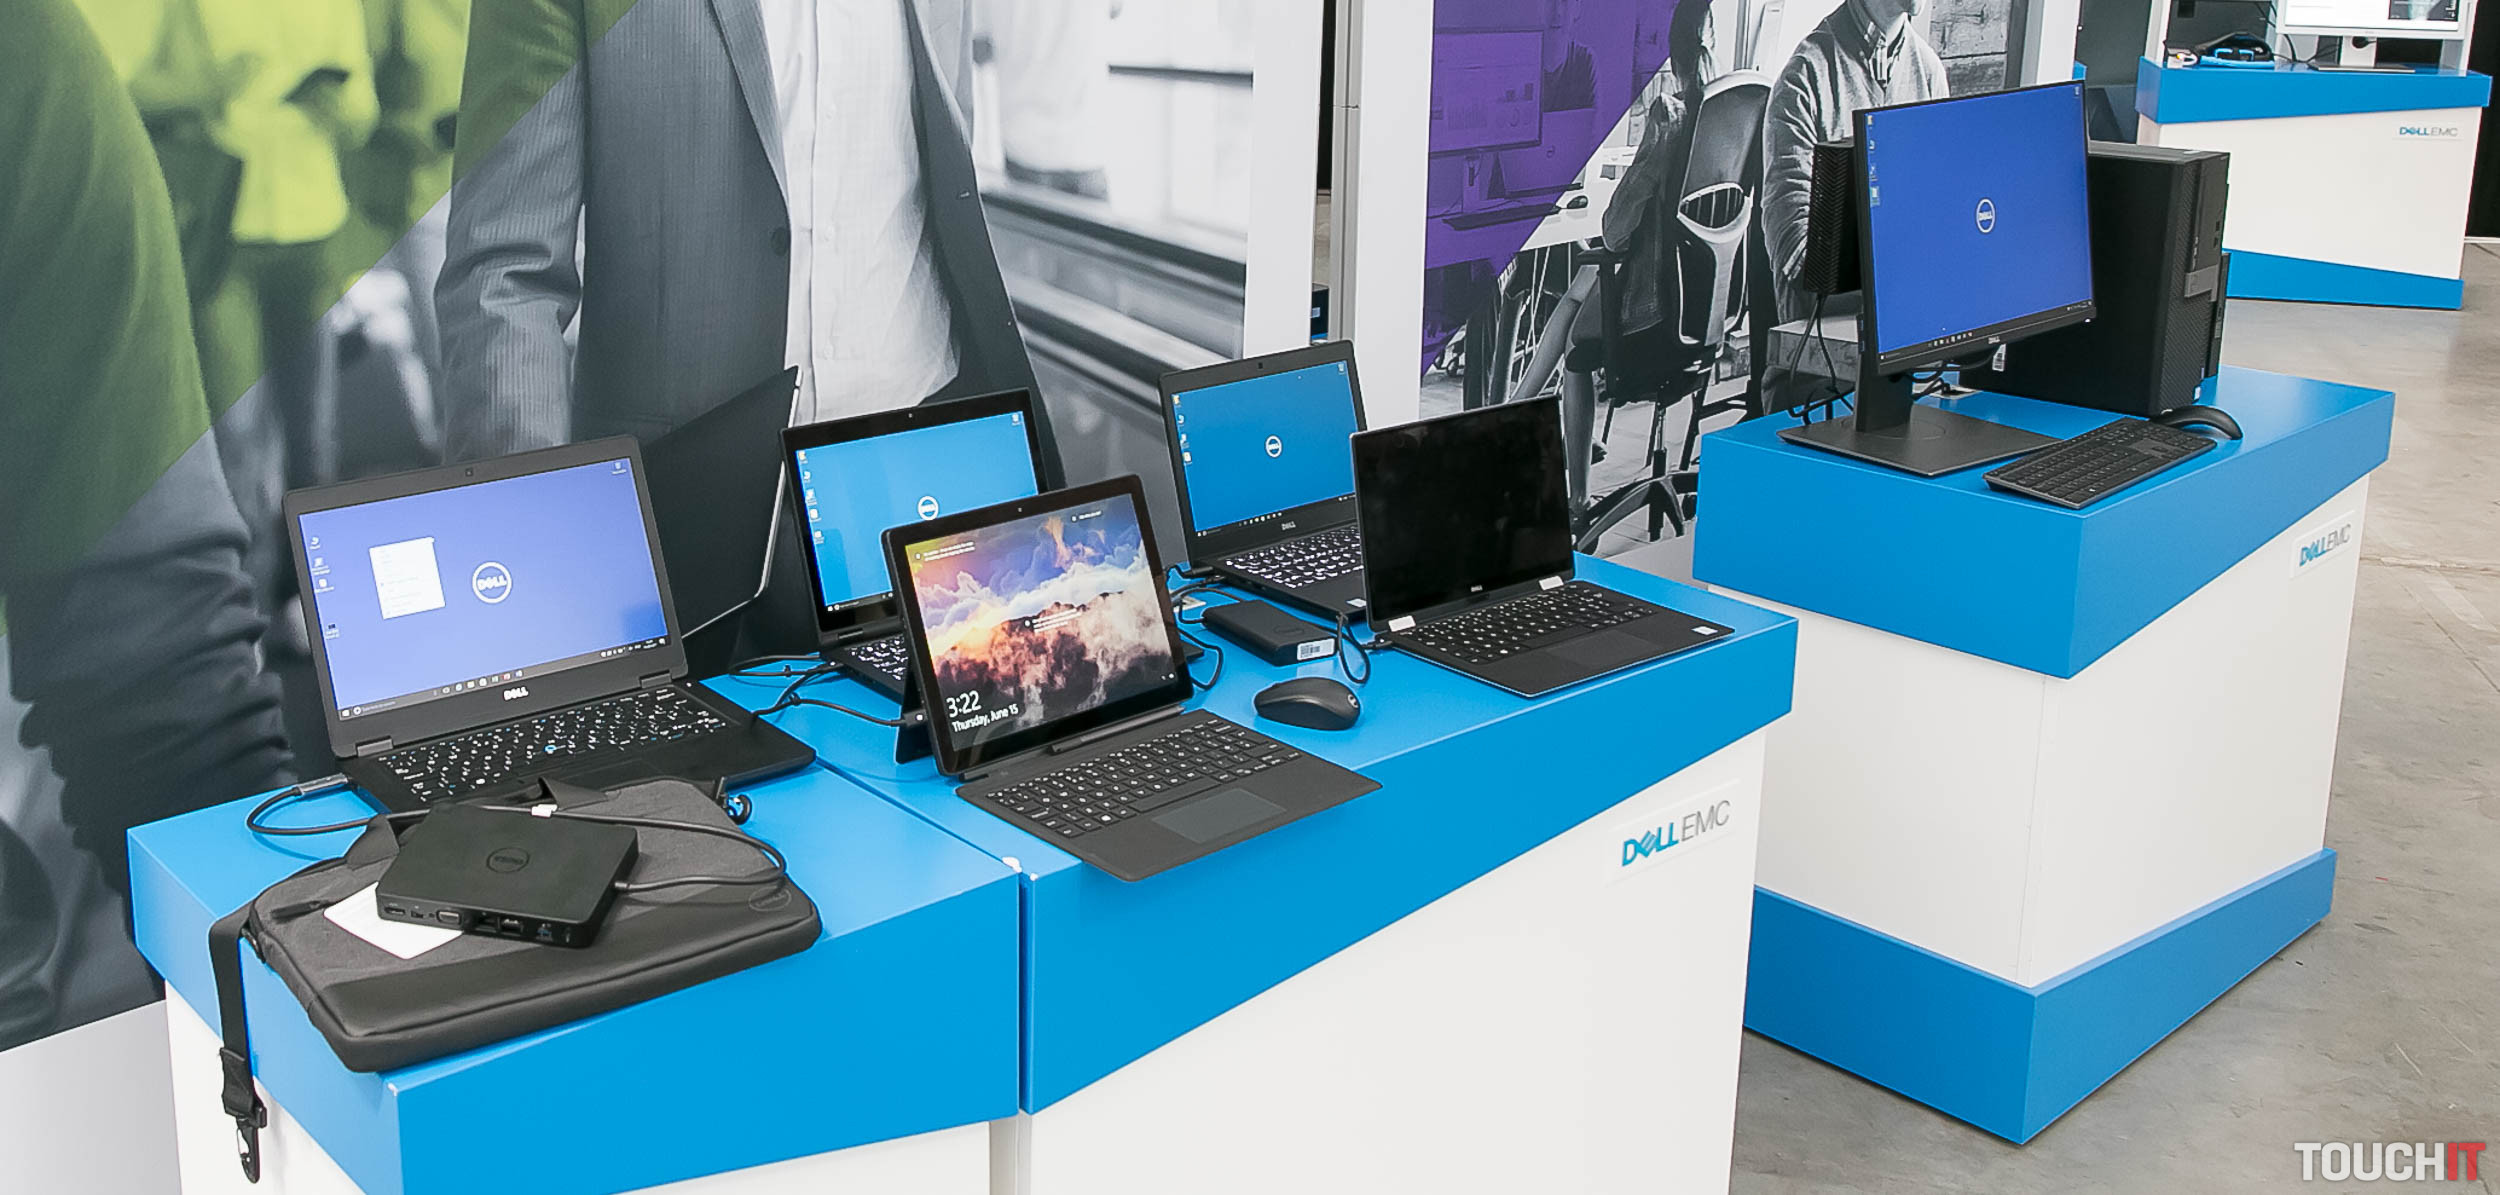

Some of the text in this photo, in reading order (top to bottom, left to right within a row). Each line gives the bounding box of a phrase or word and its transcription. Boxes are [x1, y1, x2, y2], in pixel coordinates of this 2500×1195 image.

[477, 575, 507, 591] DELL
[503, 686, 529, 701] DELL
[946, 690, 982, 718] 3:22
[951, 703, 1019, 732] Thursday, June 15
[1621, 800, 1731, 867] DELL EMC
